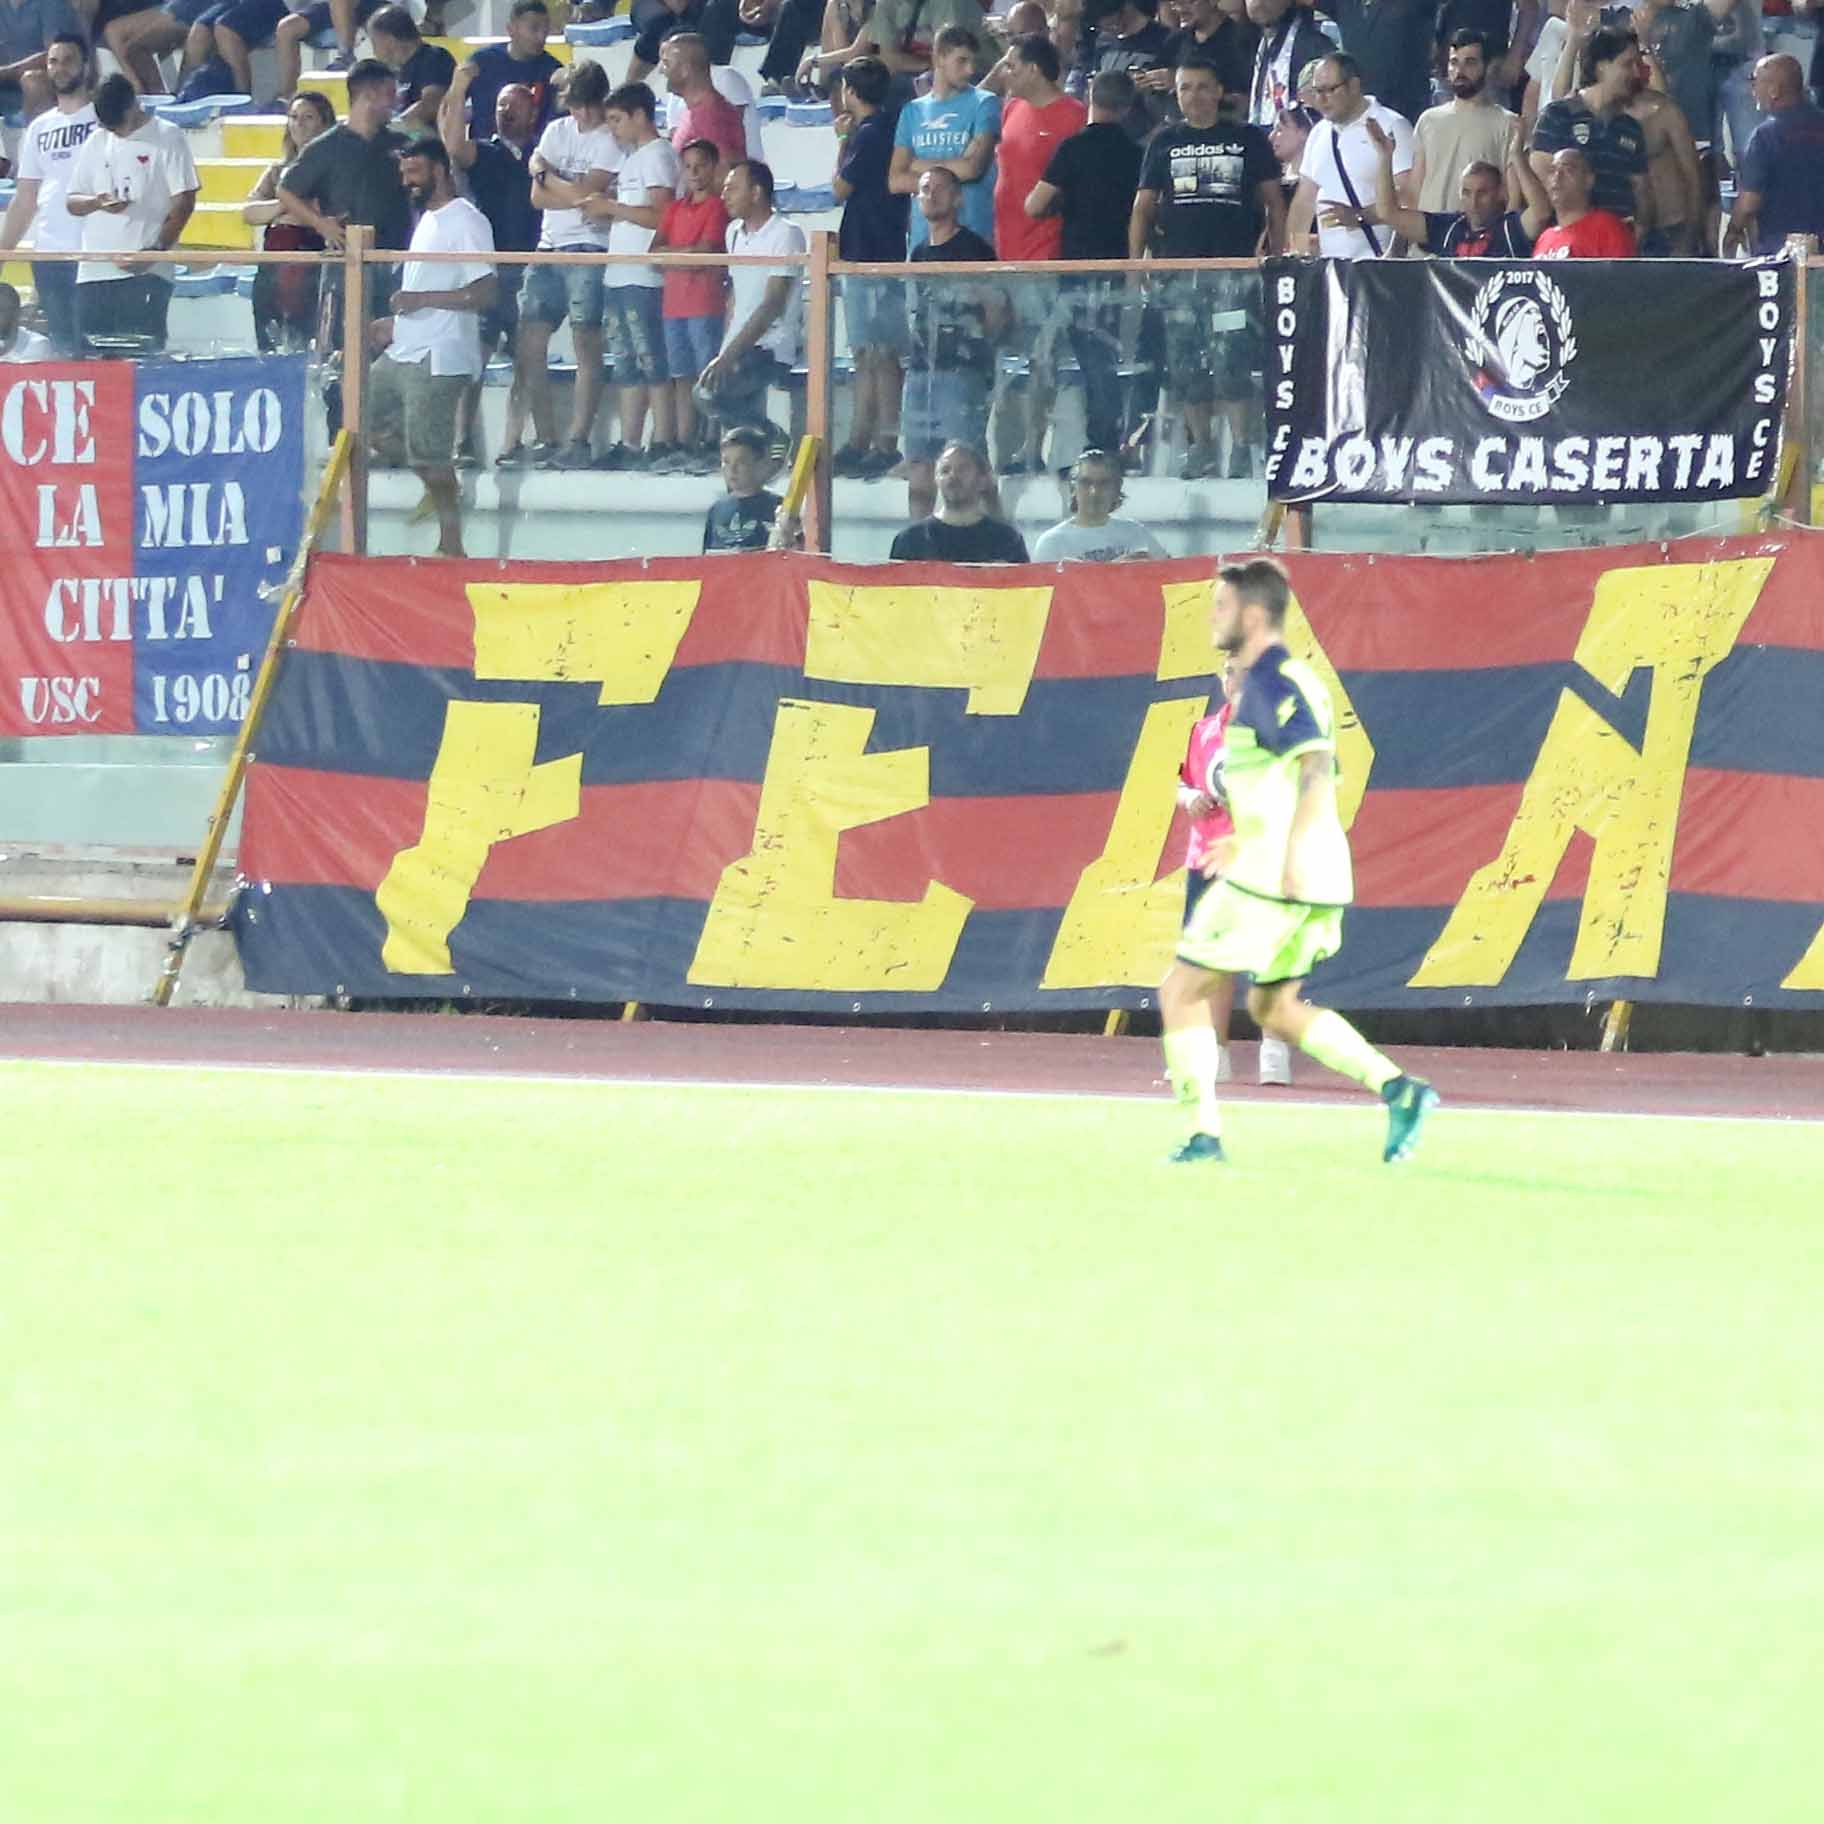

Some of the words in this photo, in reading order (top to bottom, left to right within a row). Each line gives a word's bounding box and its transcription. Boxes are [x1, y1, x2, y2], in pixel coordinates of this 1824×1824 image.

[1169, 143, 1225, 158] adidas
[1506, 271, 1535, 285] 2017
[1276, 276, 1297, 410] BOYS
[1753, 270, 1779, 405] BOYS
[1, 380, 96, 466] CE
[138, 388, 283, 459] SOLO
[1494, 400, 1526, 417] BOYS
[1528, 401, 1543, 416] CE
[1290, 436, 1455, 494] BOYS
[1471, 433, 1735, 494] CASERTA
[35, 483, 105, 548] LA
[140, 481, 251, 548] MIA
[44, 576, 225, 643] CITTA'
[19, 676, 104, 723] USC
[152, 670, 252, 723] 1908
